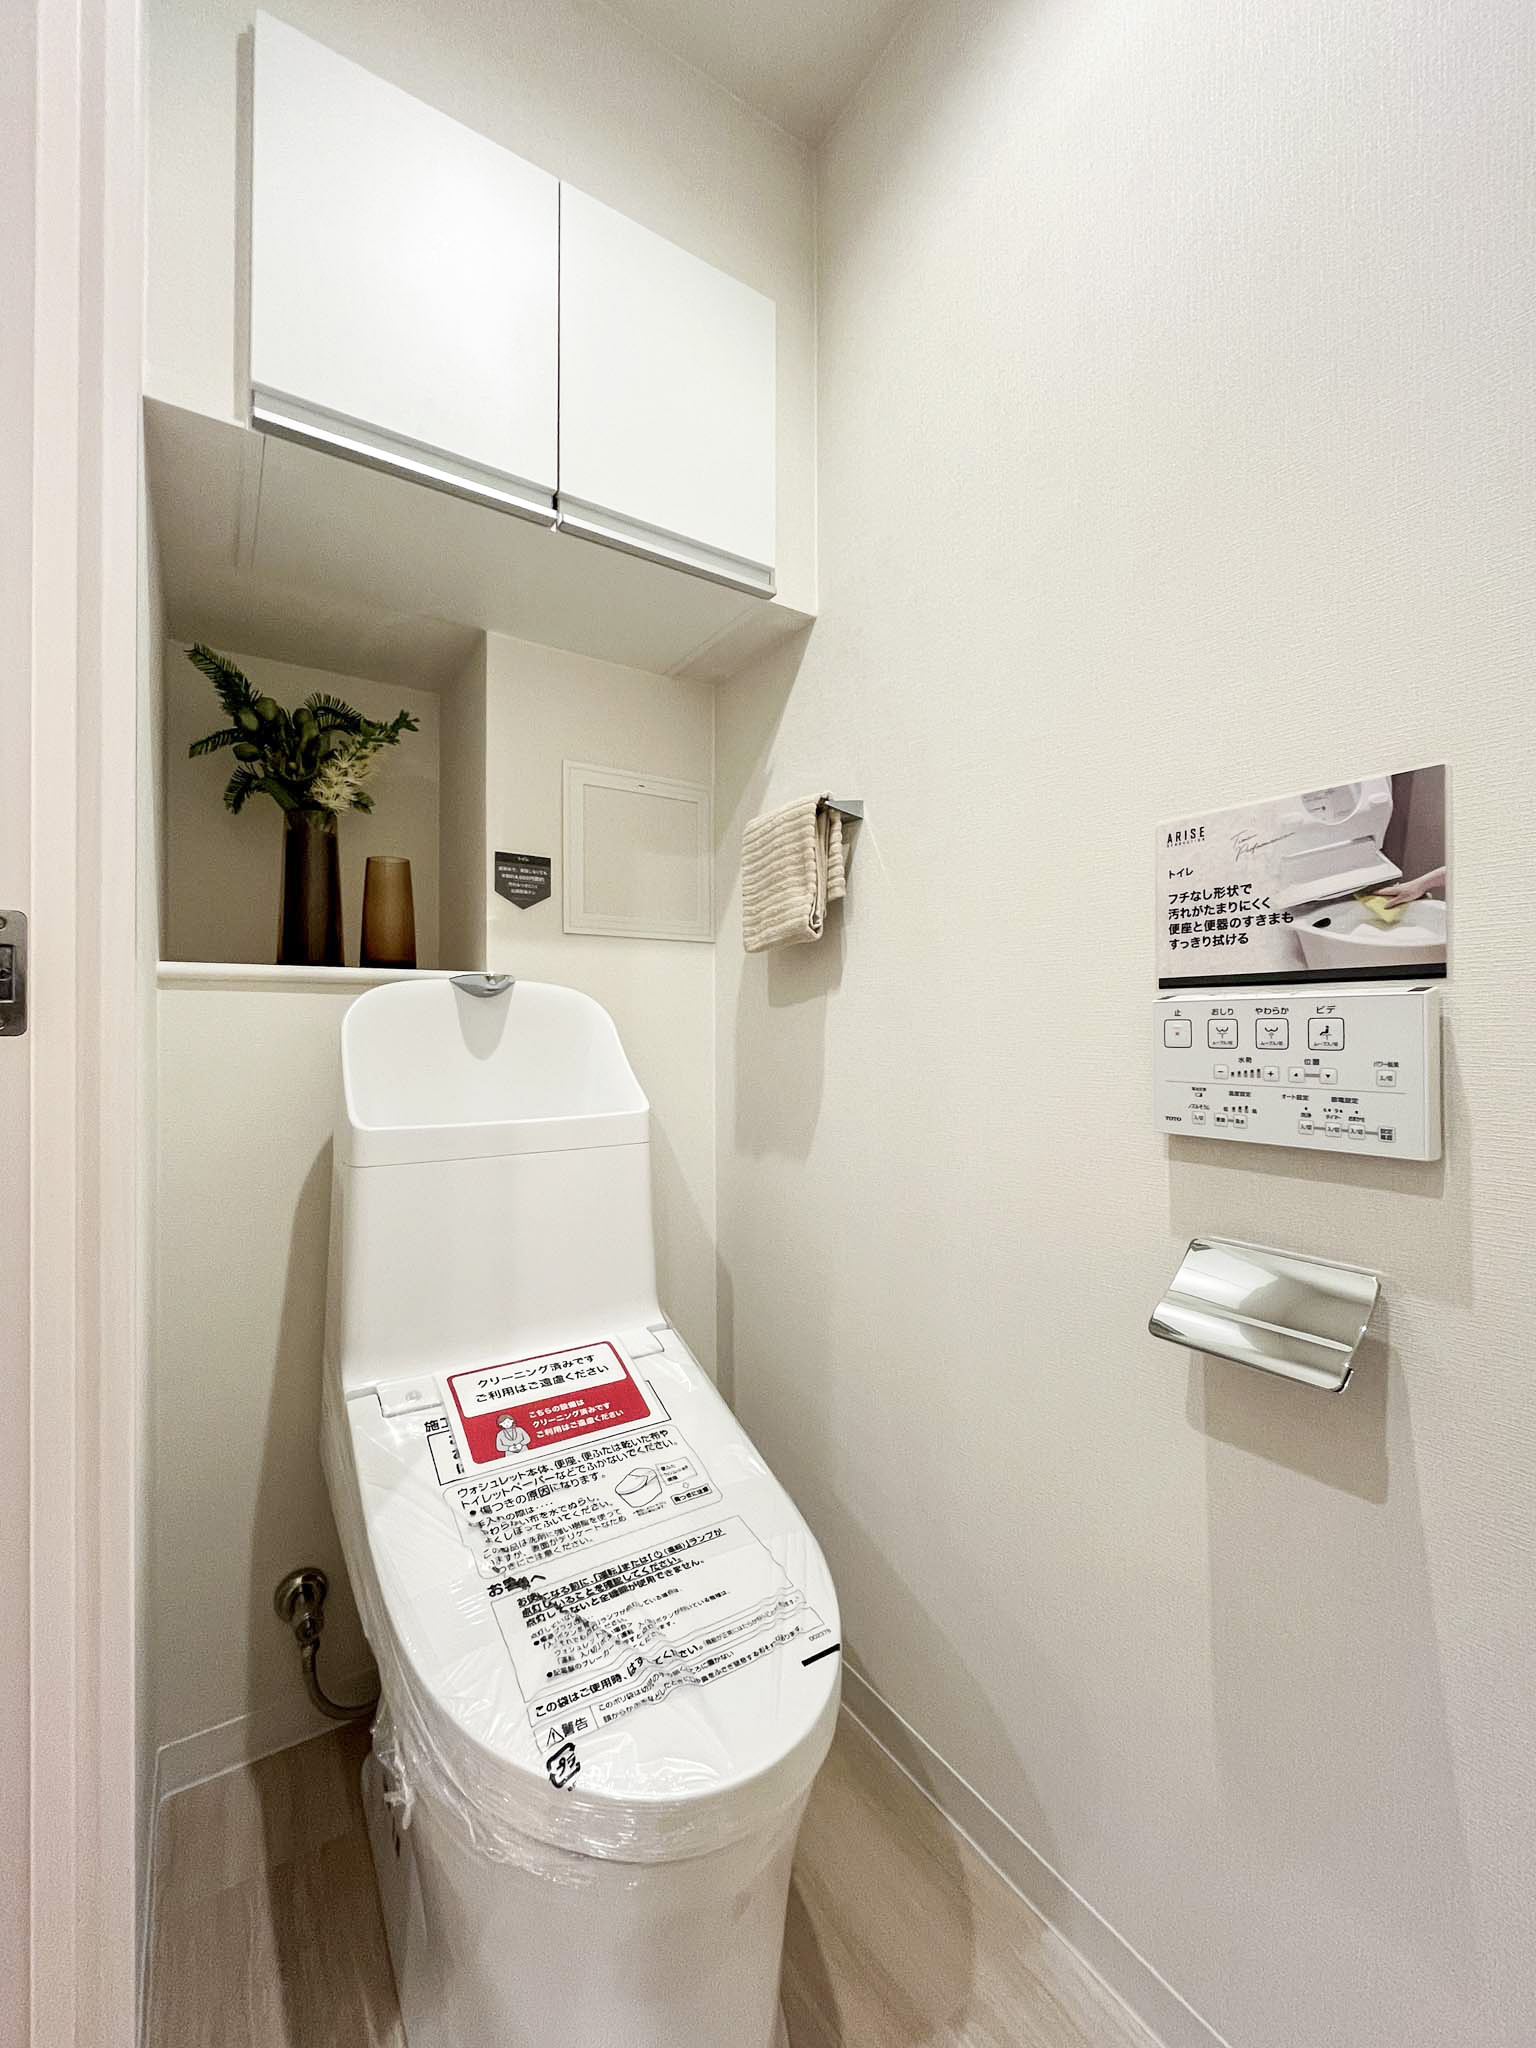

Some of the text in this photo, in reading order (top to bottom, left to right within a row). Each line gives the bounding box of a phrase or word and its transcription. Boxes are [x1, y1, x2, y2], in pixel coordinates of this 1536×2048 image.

[1167, 826, 1205, 844] ARISE
[1168, 867, 1194, 879] トイレ
[1168, 883, 1252, 904] フチなし形状で
[1168, 897, 1271, 920] 汚れがたまりにくく
[1168, 912, 1294, 935] 便座と便器のすきまも
[1169, 933, 1249, 950] すっきり拭ける
[1211, 1008, 1234, 1016] おしり
[1255, 1007, 1289, 1015] やわらか
[1316, 1005, 1336, 1014] ビデ
[477, 1354, 595, 1388] クリーニング済みです
[476, 1365, 609, 1403] ご利用はご遠慮ください
[528, 1399, 585, 1419] こちらの設備は
[532, 1402, 611, 1428] クリーニング済みです
[536, 1409, 624, 1438] ご利用はご遠慮ください
